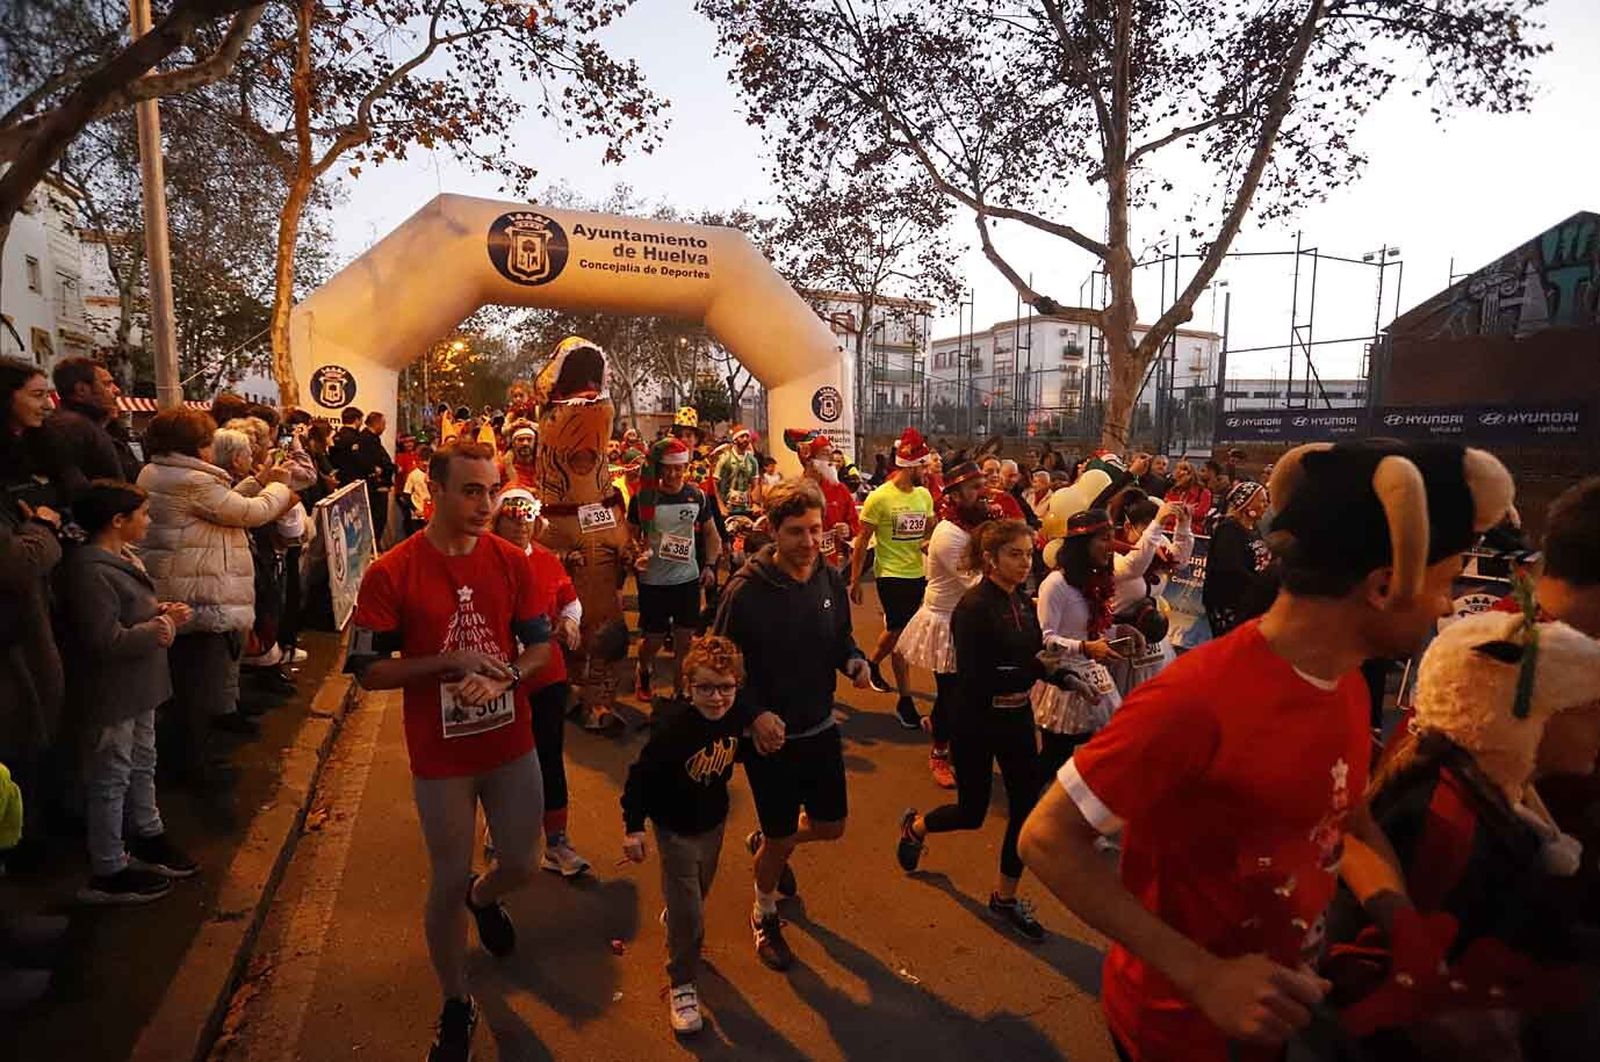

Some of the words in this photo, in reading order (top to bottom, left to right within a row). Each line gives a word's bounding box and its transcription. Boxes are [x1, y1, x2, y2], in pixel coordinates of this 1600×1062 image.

[572, 224, 707, 248] Ayuntamiento
[612, 243, 636, 258] de
[643, 245, 708, 265] Huelva
[643, 265, 657, 275] de
[660, 266, 710, 279] Deportes
[1405, 415, 1464, 425] HYUNDAI
[1507, 412, 1579, 424] HYUNDAI
[593, 509, 612, 522] 393
[908, 519, 924, 530] 239
[672, 543, 690, 556] 388
